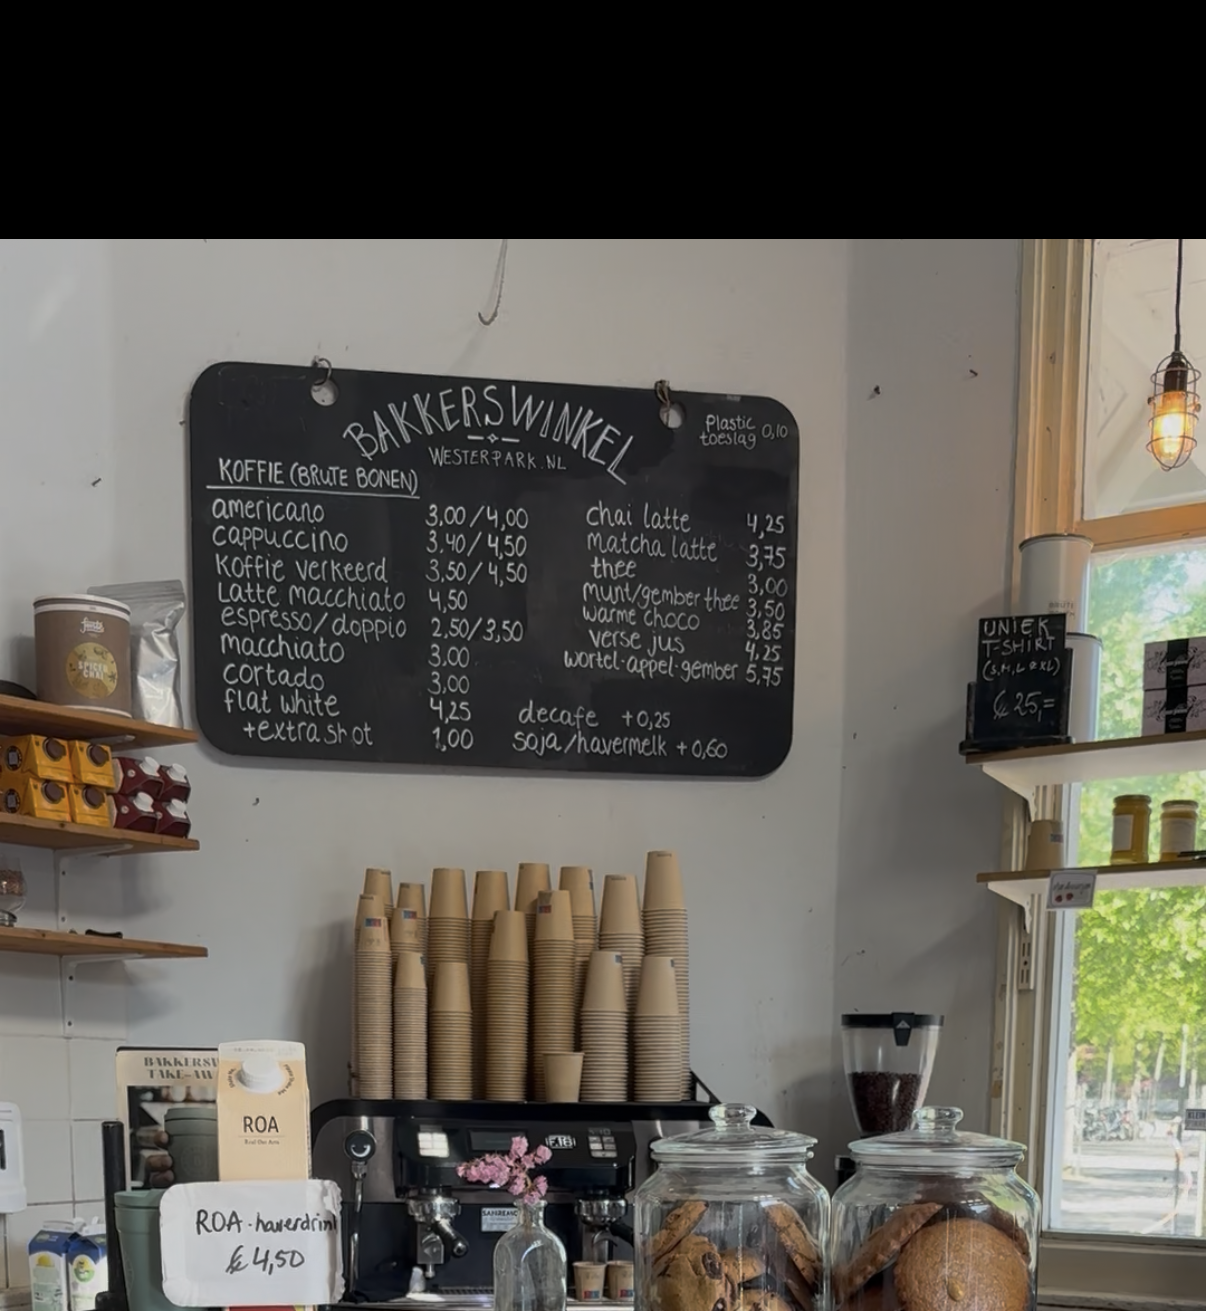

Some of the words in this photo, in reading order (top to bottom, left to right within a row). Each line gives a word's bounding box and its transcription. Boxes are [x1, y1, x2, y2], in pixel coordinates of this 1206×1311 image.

[342, 385, 634, 485] BAKKERSWINKEL
[705, 414, 756, 433] Plastic
[699, 431, 756, 450] toeslag
[218, 458, 285, 484] KOFFIE
[212, 497, 325, 523] americano
[586, 500, 632, 527] chai
[643, 502, 691, 533] latte
[746, 513, 785, 539] 4,25
[212, 525, 348, 552] cappuccino
[587, 531, 666, 557] matcha
[672, 535, 717, 562] latte
[745, 544, 786, 571] 3,75
[297, 557, 389, 583] verkeerd
[591, 556, 637, 579] thee
[747, 574, 788, 598] 3,00
[218, 582, 280, 607] Latte
[289, 585, 406, 612] macchiato
[429, 588, 468, 613] 4,50
[704, 587, 740, 612] thee
[746, 599, 785, 621] 3,50
[583, 606, 636, 628] warme
[644, 607, 700, 631] choco
[746, 619, 785, 640] 3,85
[984, 617, 1048, 637] UNIEK
[220, 632, 345, 664] macchiato
[588, 629, 642, 650] verse
[646, 630, 685, 657] jus
[745, 640, 782, 662] 4,25
[982, 637, 1055, 658] T-SHIRT
[223, 663, 325, 691] cortado
[745, 664, 785, 687] 5,75
[223, 688, 272, 715] flat
[280, 690, 341, 718] white
[429, 697, 471, 724] 4,25
[518, 700, 599, 728] decafe
[243, 1115, 279, 1133] ROA
